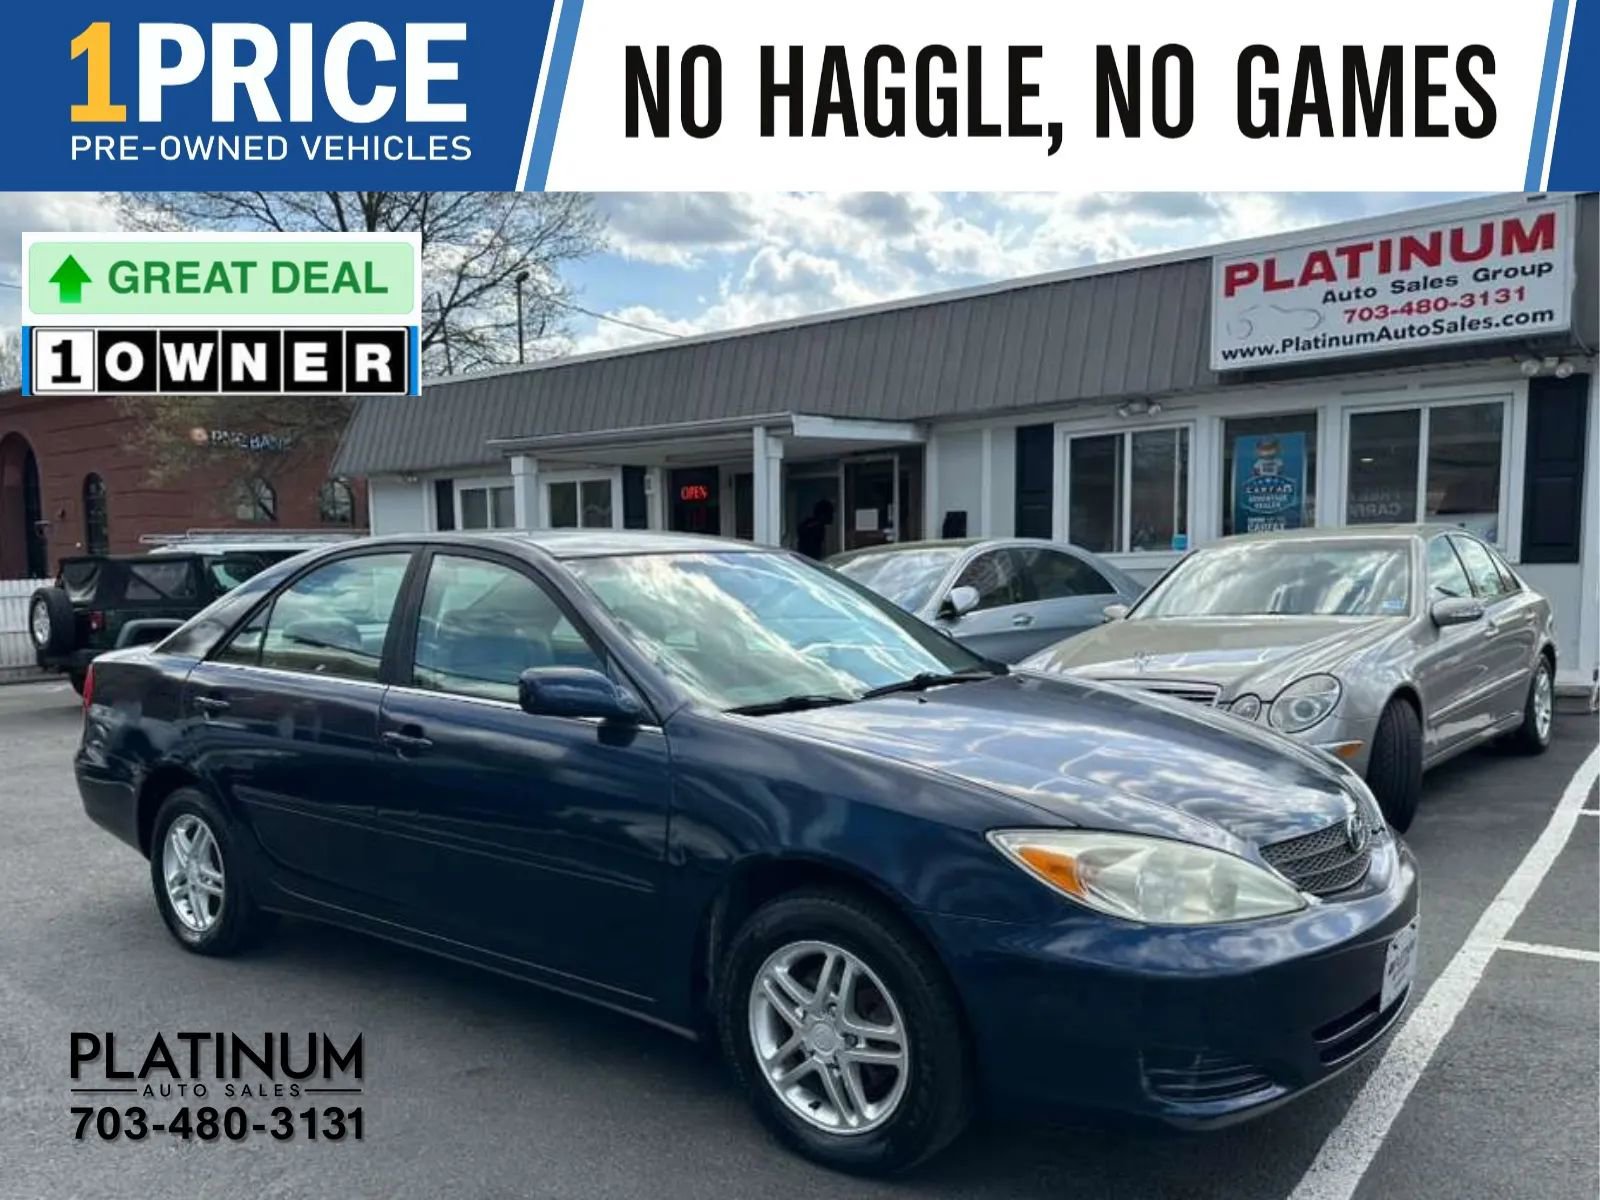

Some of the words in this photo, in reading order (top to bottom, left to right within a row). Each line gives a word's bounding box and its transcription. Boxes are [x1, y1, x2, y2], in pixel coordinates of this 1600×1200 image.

[1224, 212, 1556, 297] PLATINUM
[1322, 287, 1377, 304] Auto
[1391, 273, 1458, 294] Sales
[1473, 261, 1553, 283] Group
[1344, 286, 1526, 323] 703-480-3131
[1221, 308, 1554, 361] www.PlatinumAutoSales.com
[681, 486, 708, 500] OPEN
